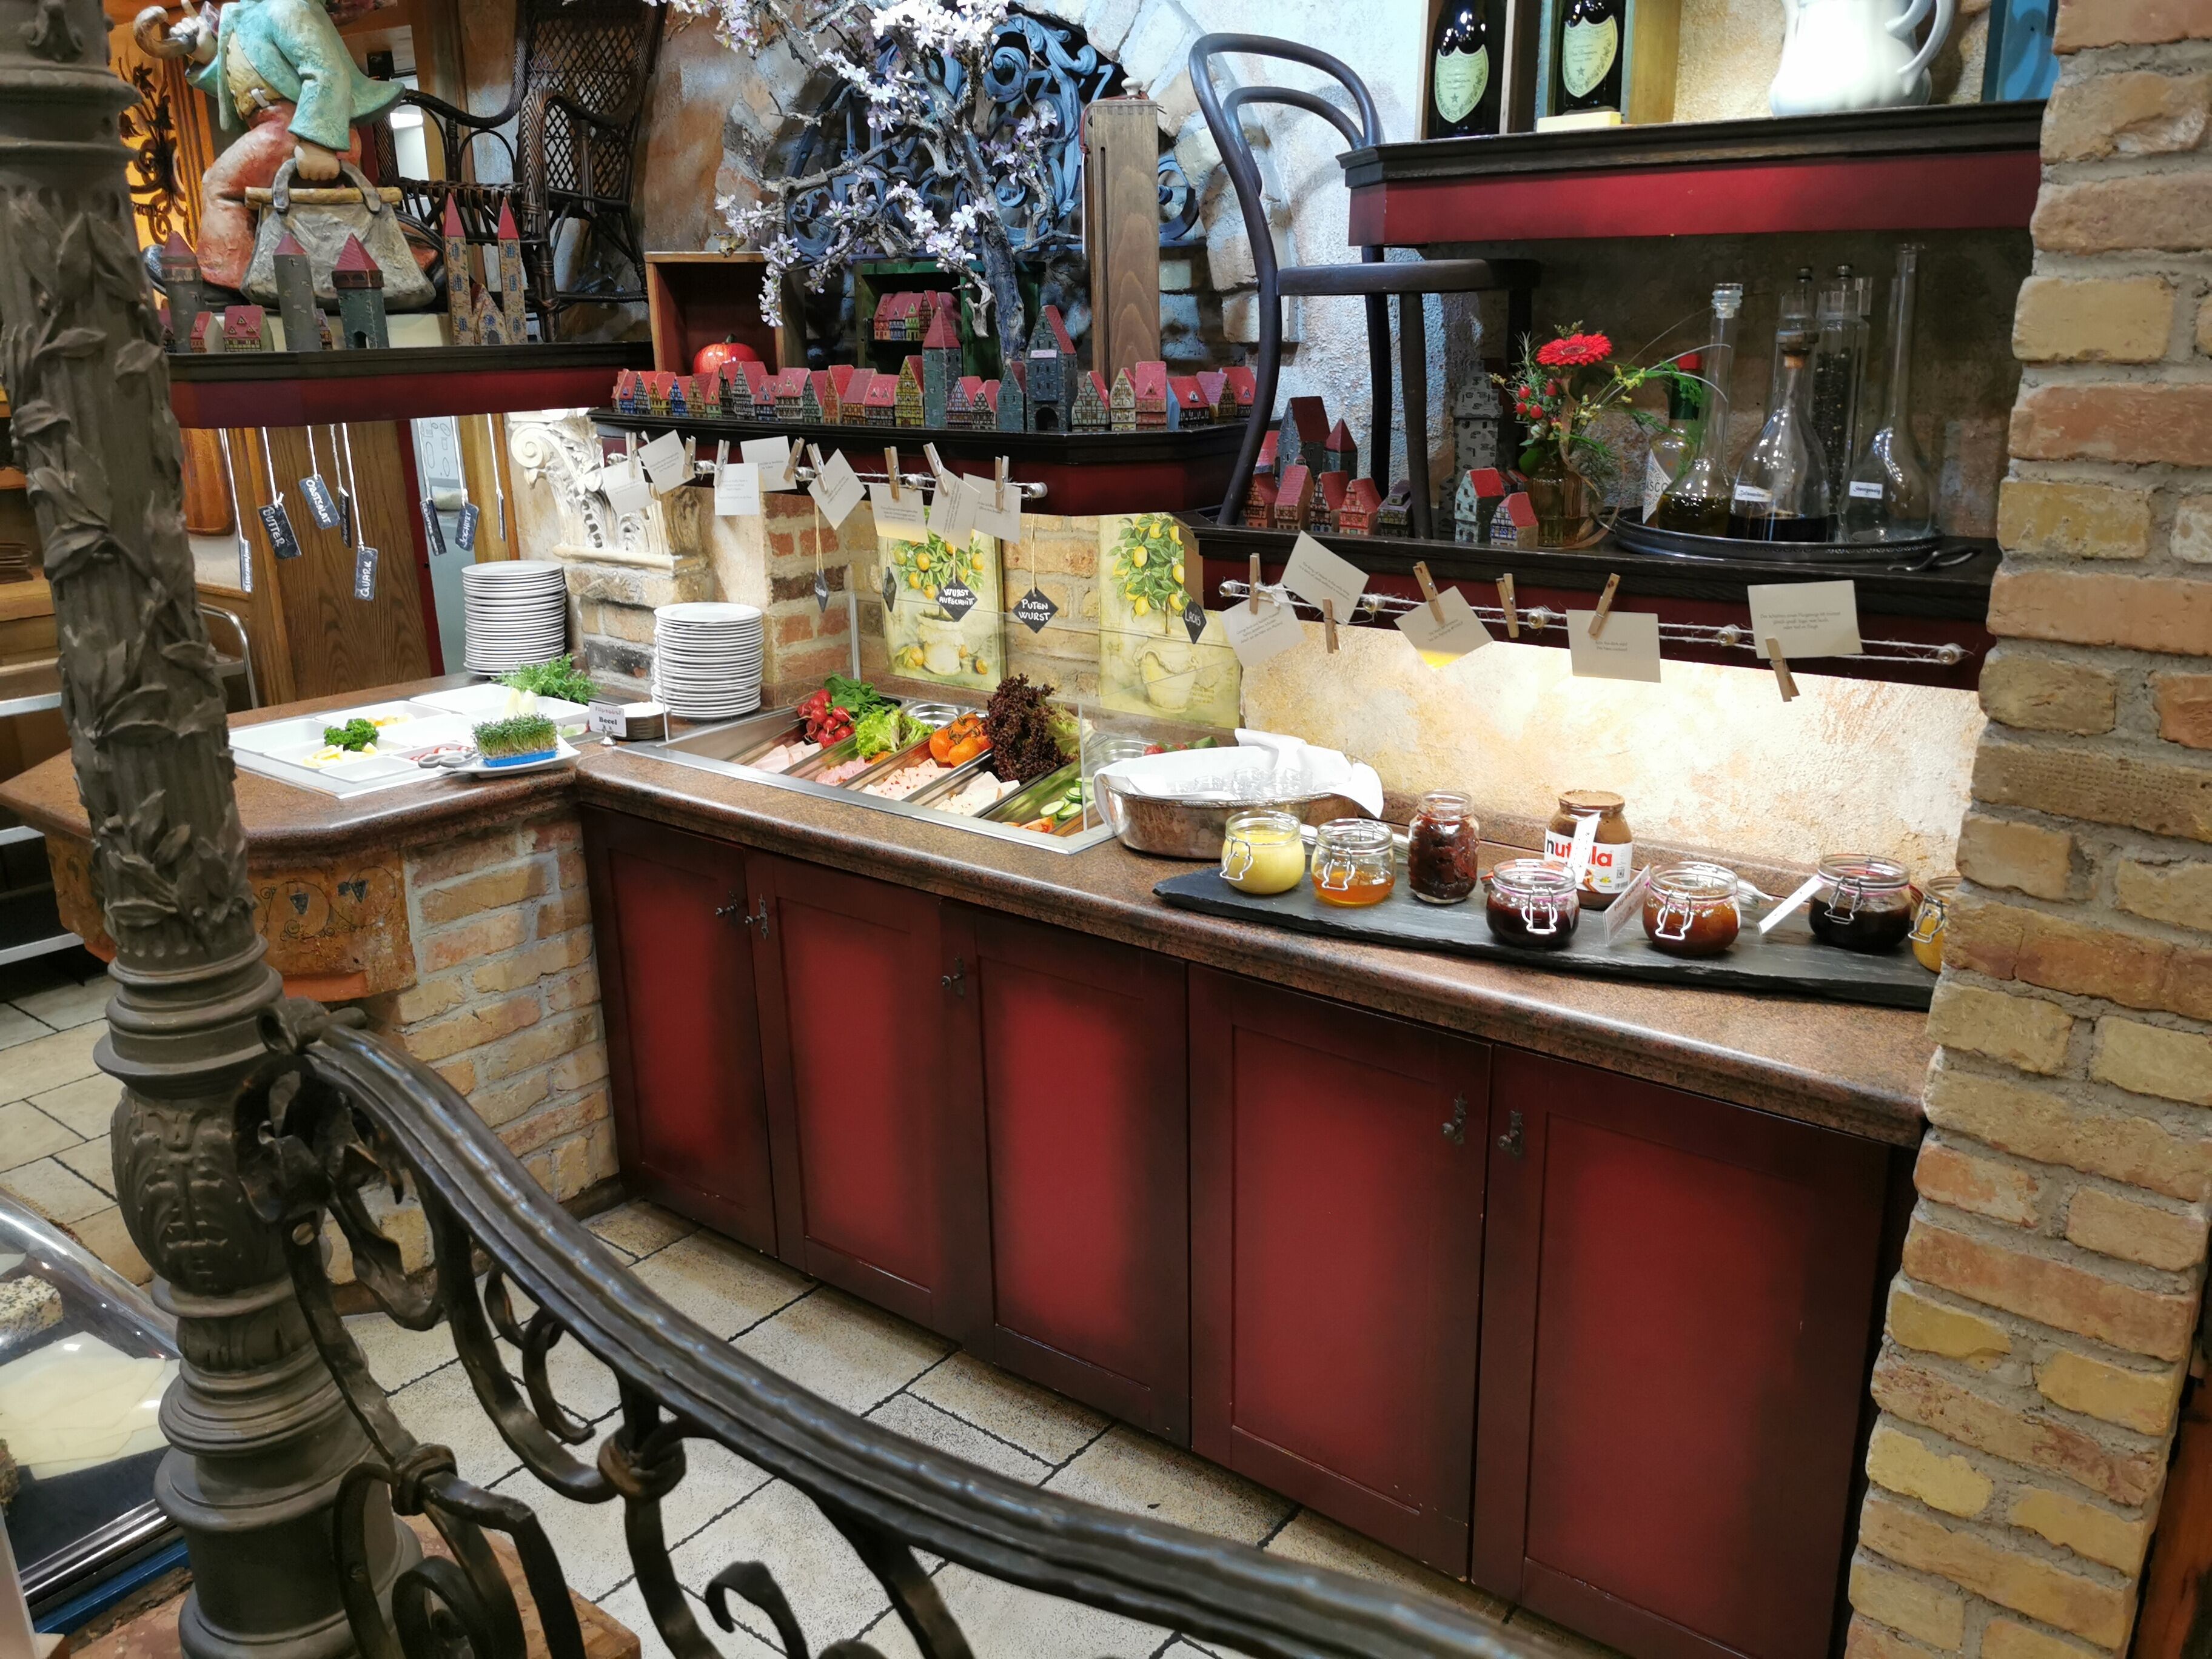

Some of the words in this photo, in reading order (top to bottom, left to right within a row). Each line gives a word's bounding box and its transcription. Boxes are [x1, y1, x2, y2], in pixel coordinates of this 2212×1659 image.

[263, 506, 286, 548] BUTTER
[360, 560, 372, 597] QUARK
[943, 588, 969, 597] WURST
[1021, 598, 1048, 610] PUTEN
[1018, 611, 1051, 622] WURST
[598, 716, 617, 725] Becel
[1547, 839, 1613, 867] nutla
